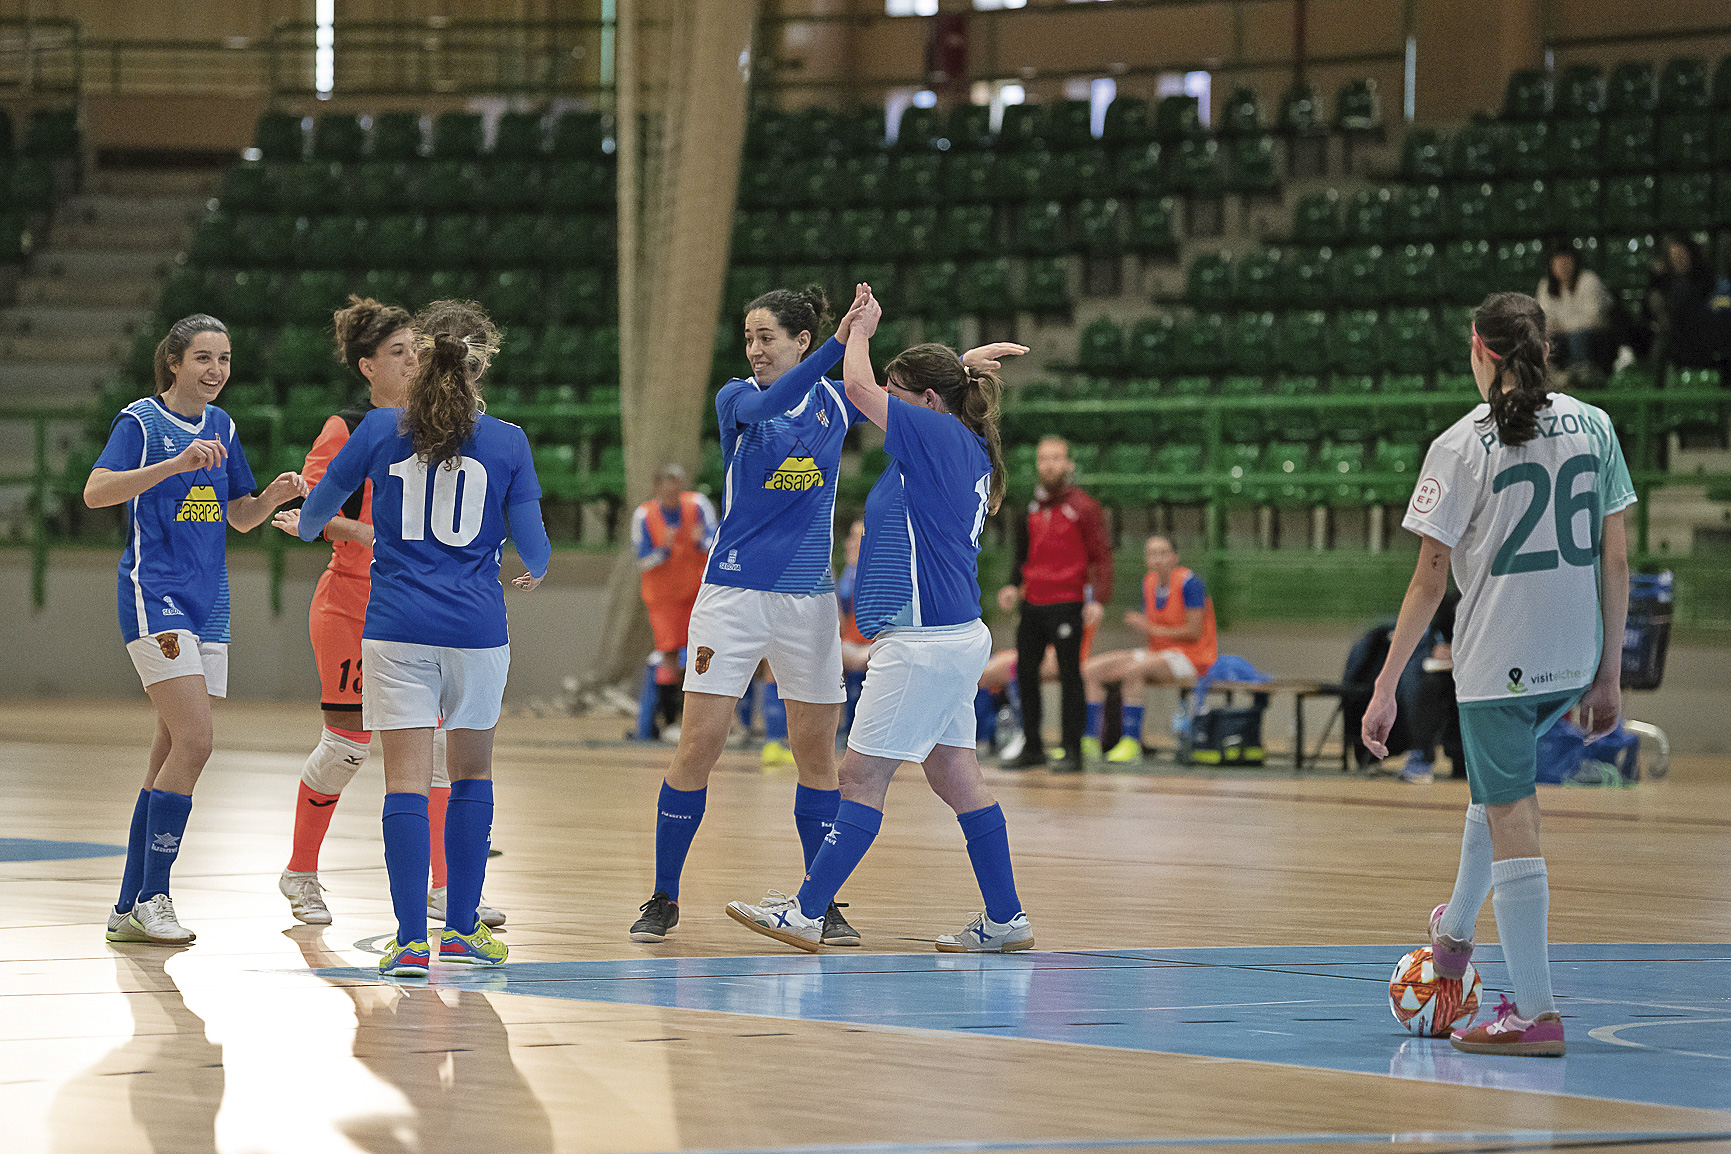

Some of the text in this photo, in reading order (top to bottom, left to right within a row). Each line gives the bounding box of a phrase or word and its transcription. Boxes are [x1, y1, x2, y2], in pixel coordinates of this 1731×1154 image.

[1480, 413, 1598, 455] PAZON
[388, 452, 488, 547] 10
[1491, 453, 1600, 577] 26
